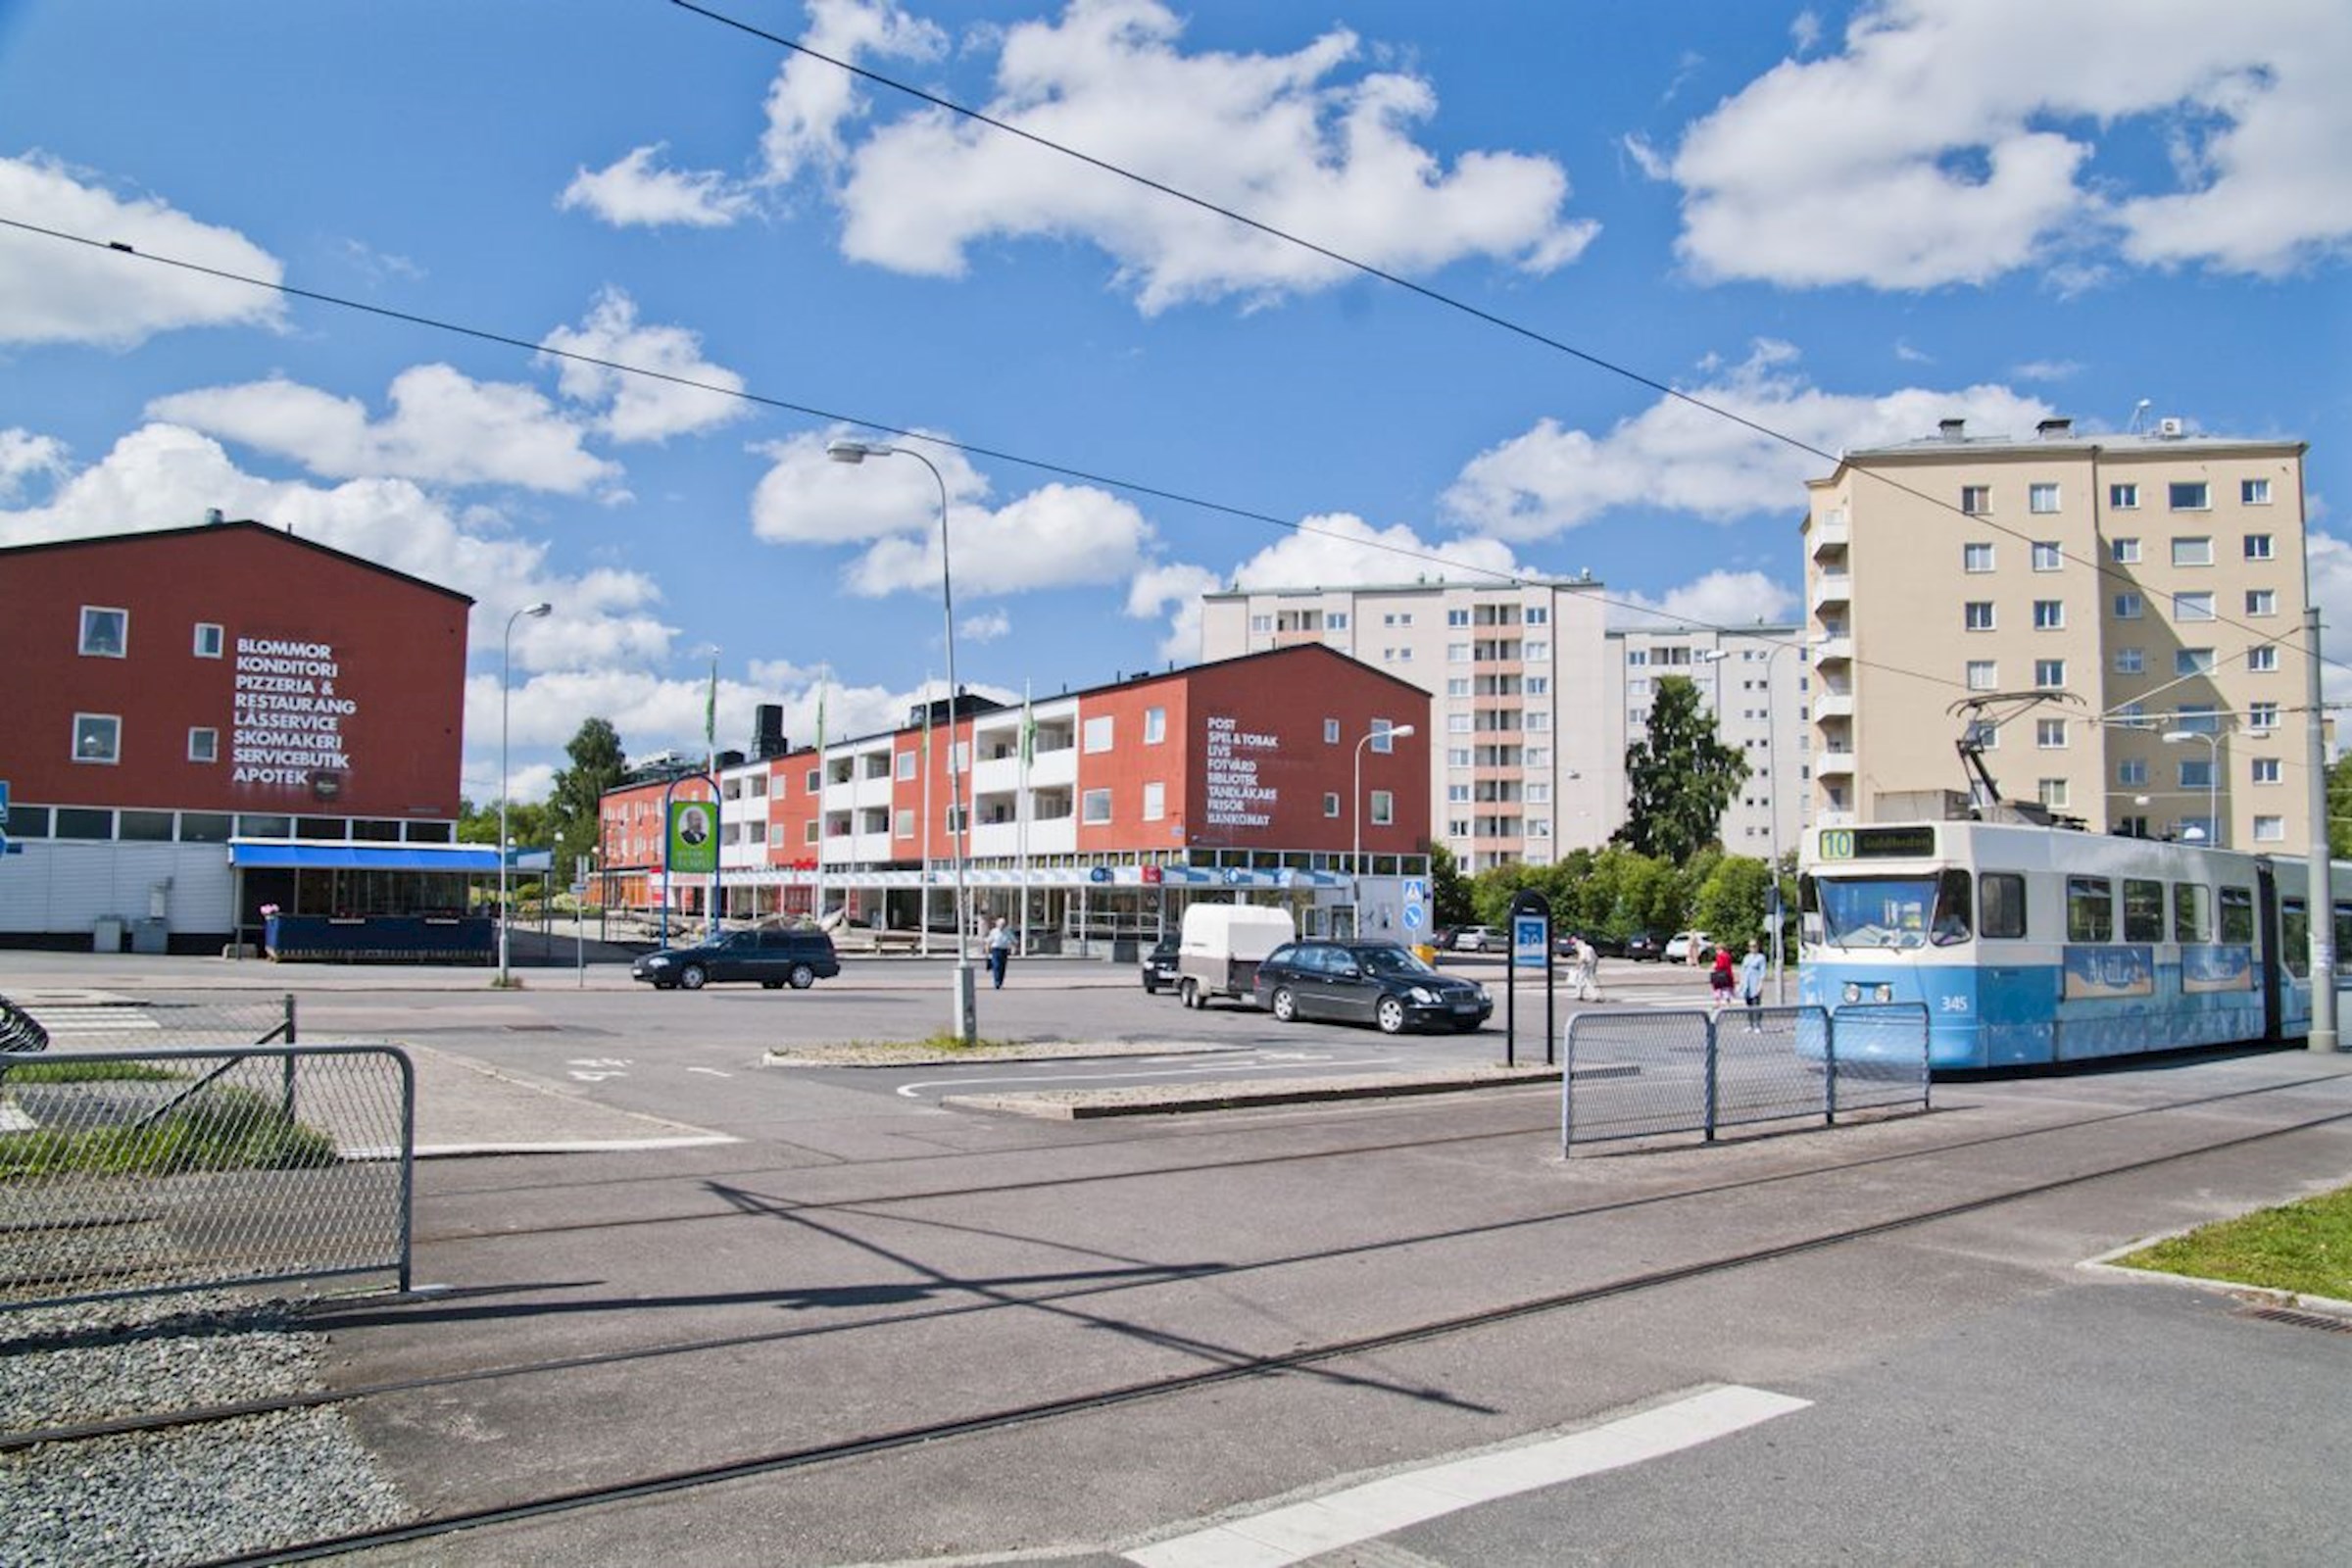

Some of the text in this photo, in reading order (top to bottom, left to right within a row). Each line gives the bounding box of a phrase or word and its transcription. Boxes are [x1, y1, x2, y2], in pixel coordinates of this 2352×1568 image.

[237, 638, 331, 660] BLOMMOR
[236, 656, 338, 677] KONDITORI
[236, 674, 333, 695] PIZZERIA &
[235, 693, 356, 714] RESTAURANG
[234, 710, 337, 731] LÅSSERVICE
[1207, 716, 1236, 730] POST
[233, 729, 342, 749] SKOMAKERI
[1207, 730, 1232, 744] SPEL
[1242, 733, 1278, 748] TOBAK
[233, 748, 349, 768] SERVICEBUTIK
[1207, 745, 1231, 757] LIVS
[1207, 757, 1257, 772] FOTVÅRD
[233, 767, 309, 785] APOTEK
[1207, 772, 1258, 786] BIBLIOTEK
[1207, 812, 1271, 825] BANKOMAT
[1826, 831, 1851, 857] 10
[1941, 996, 1968, 1011] 345
